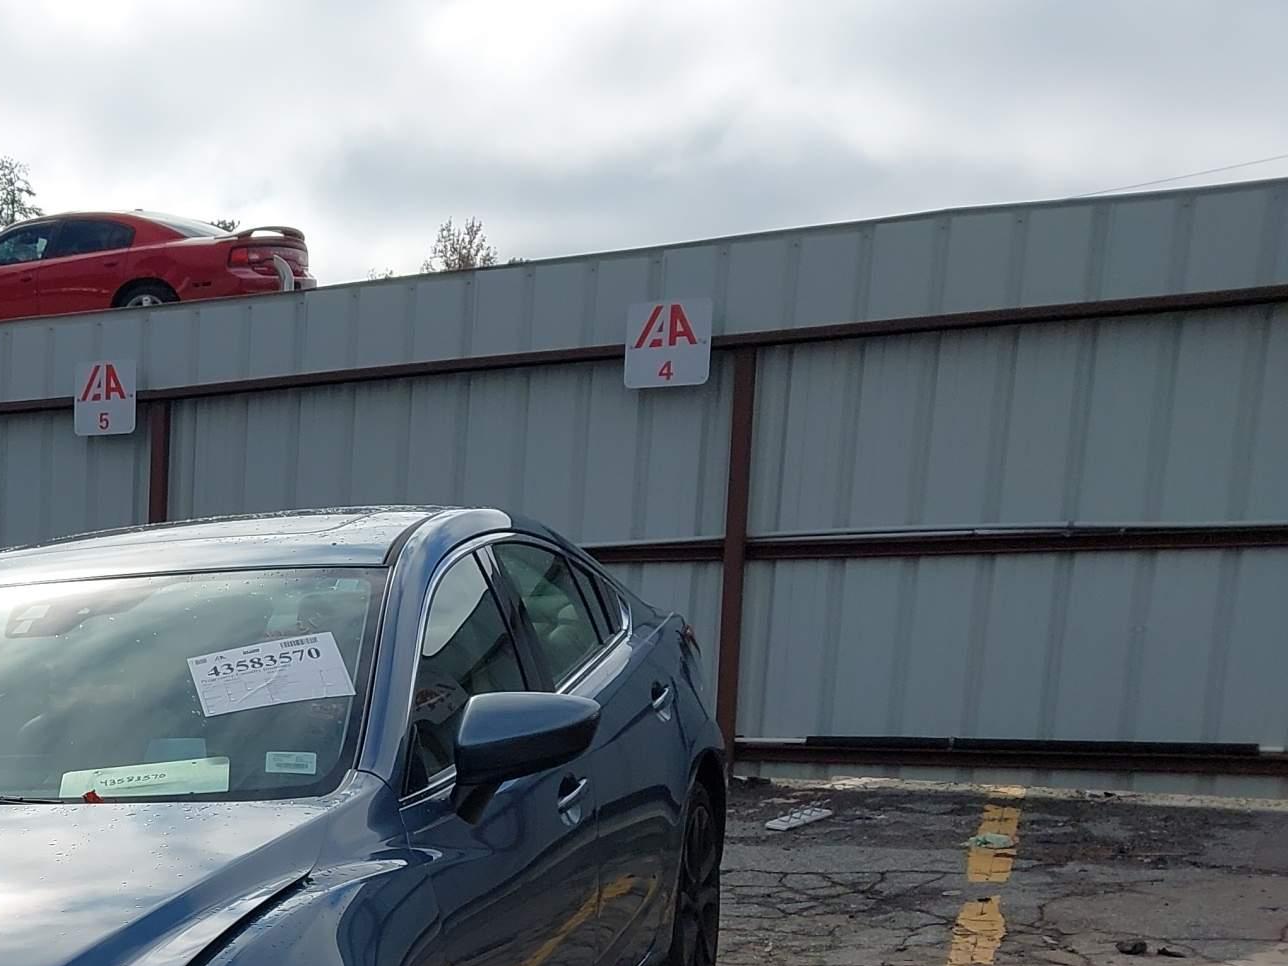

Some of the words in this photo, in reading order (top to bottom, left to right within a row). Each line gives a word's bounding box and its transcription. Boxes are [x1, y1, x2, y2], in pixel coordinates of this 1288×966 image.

[657, 360, 674, 381] 4
[98, 411, 110, 430] 5
[207, 647, 321, 677] 43583570
